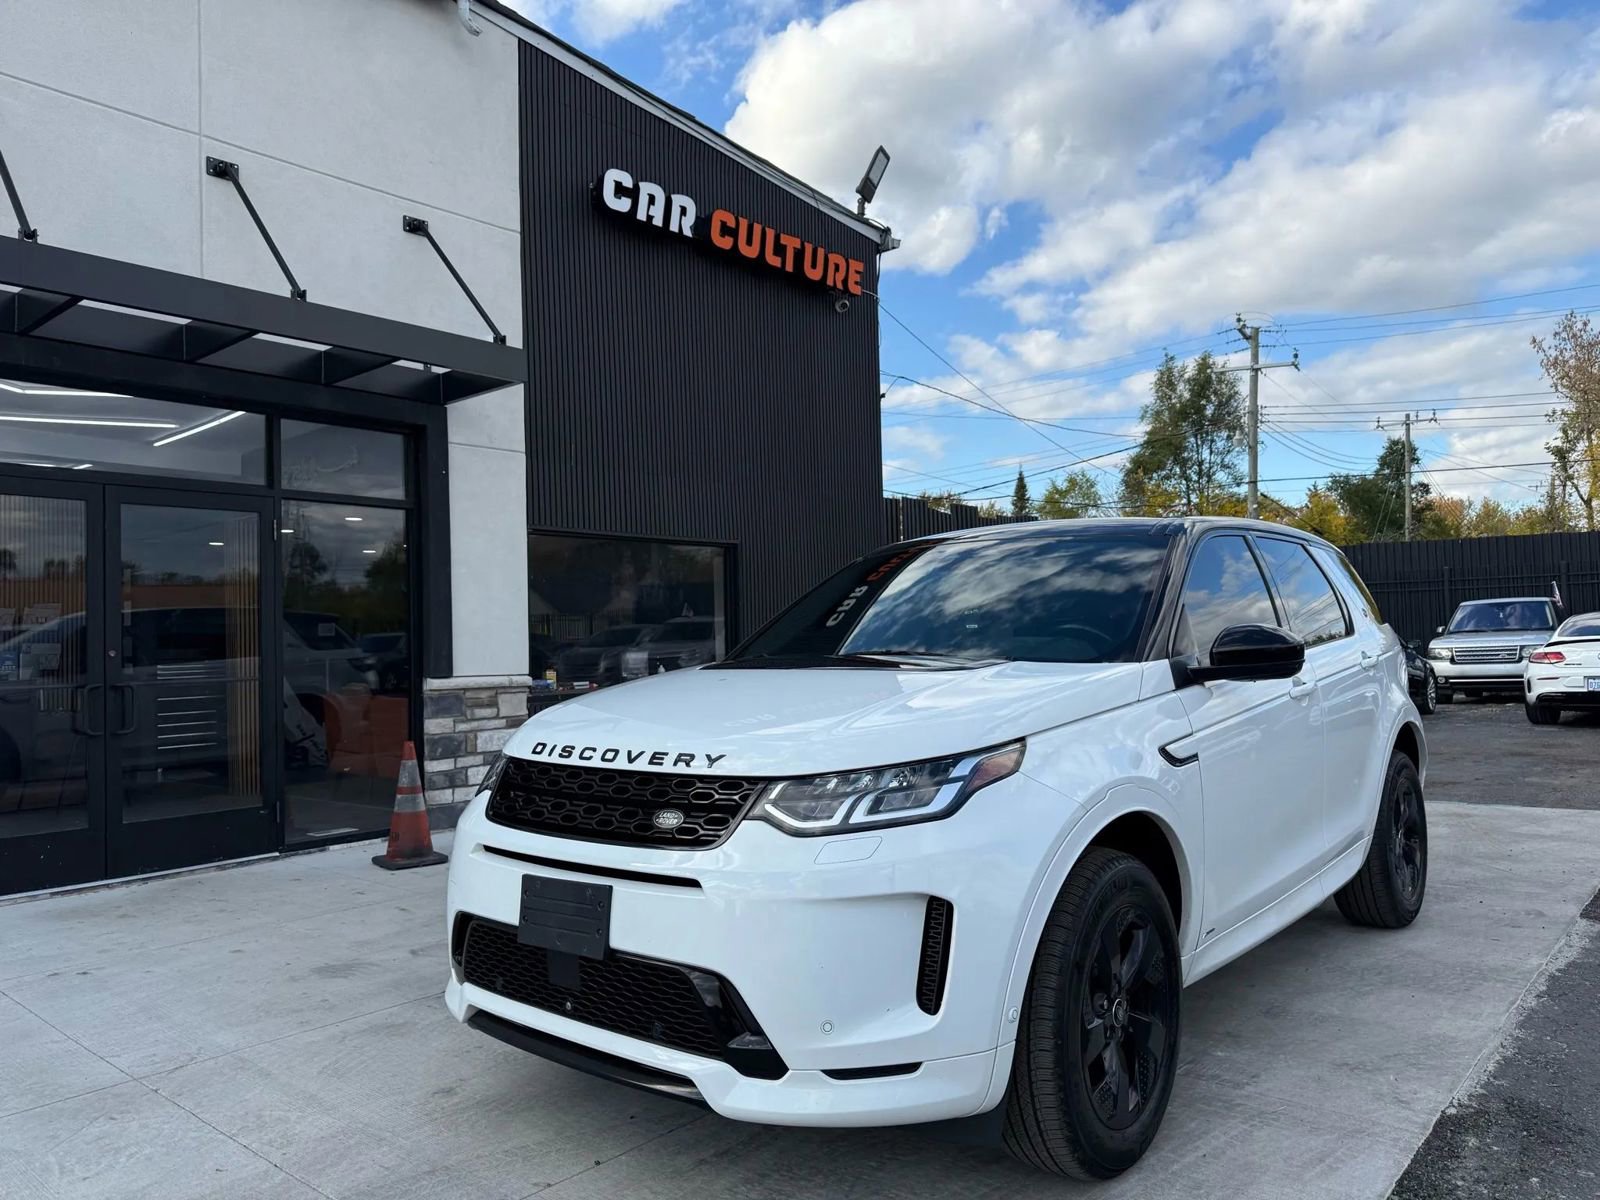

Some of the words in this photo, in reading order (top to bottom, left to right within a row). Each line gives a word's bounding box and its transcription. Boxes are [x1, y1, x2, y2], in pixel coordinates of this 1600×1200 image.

[603, 168, 697, 237] CAR
[711, 209, 864, 295] CULTURE
[531, 742, 727, 768] DISCOVERY
